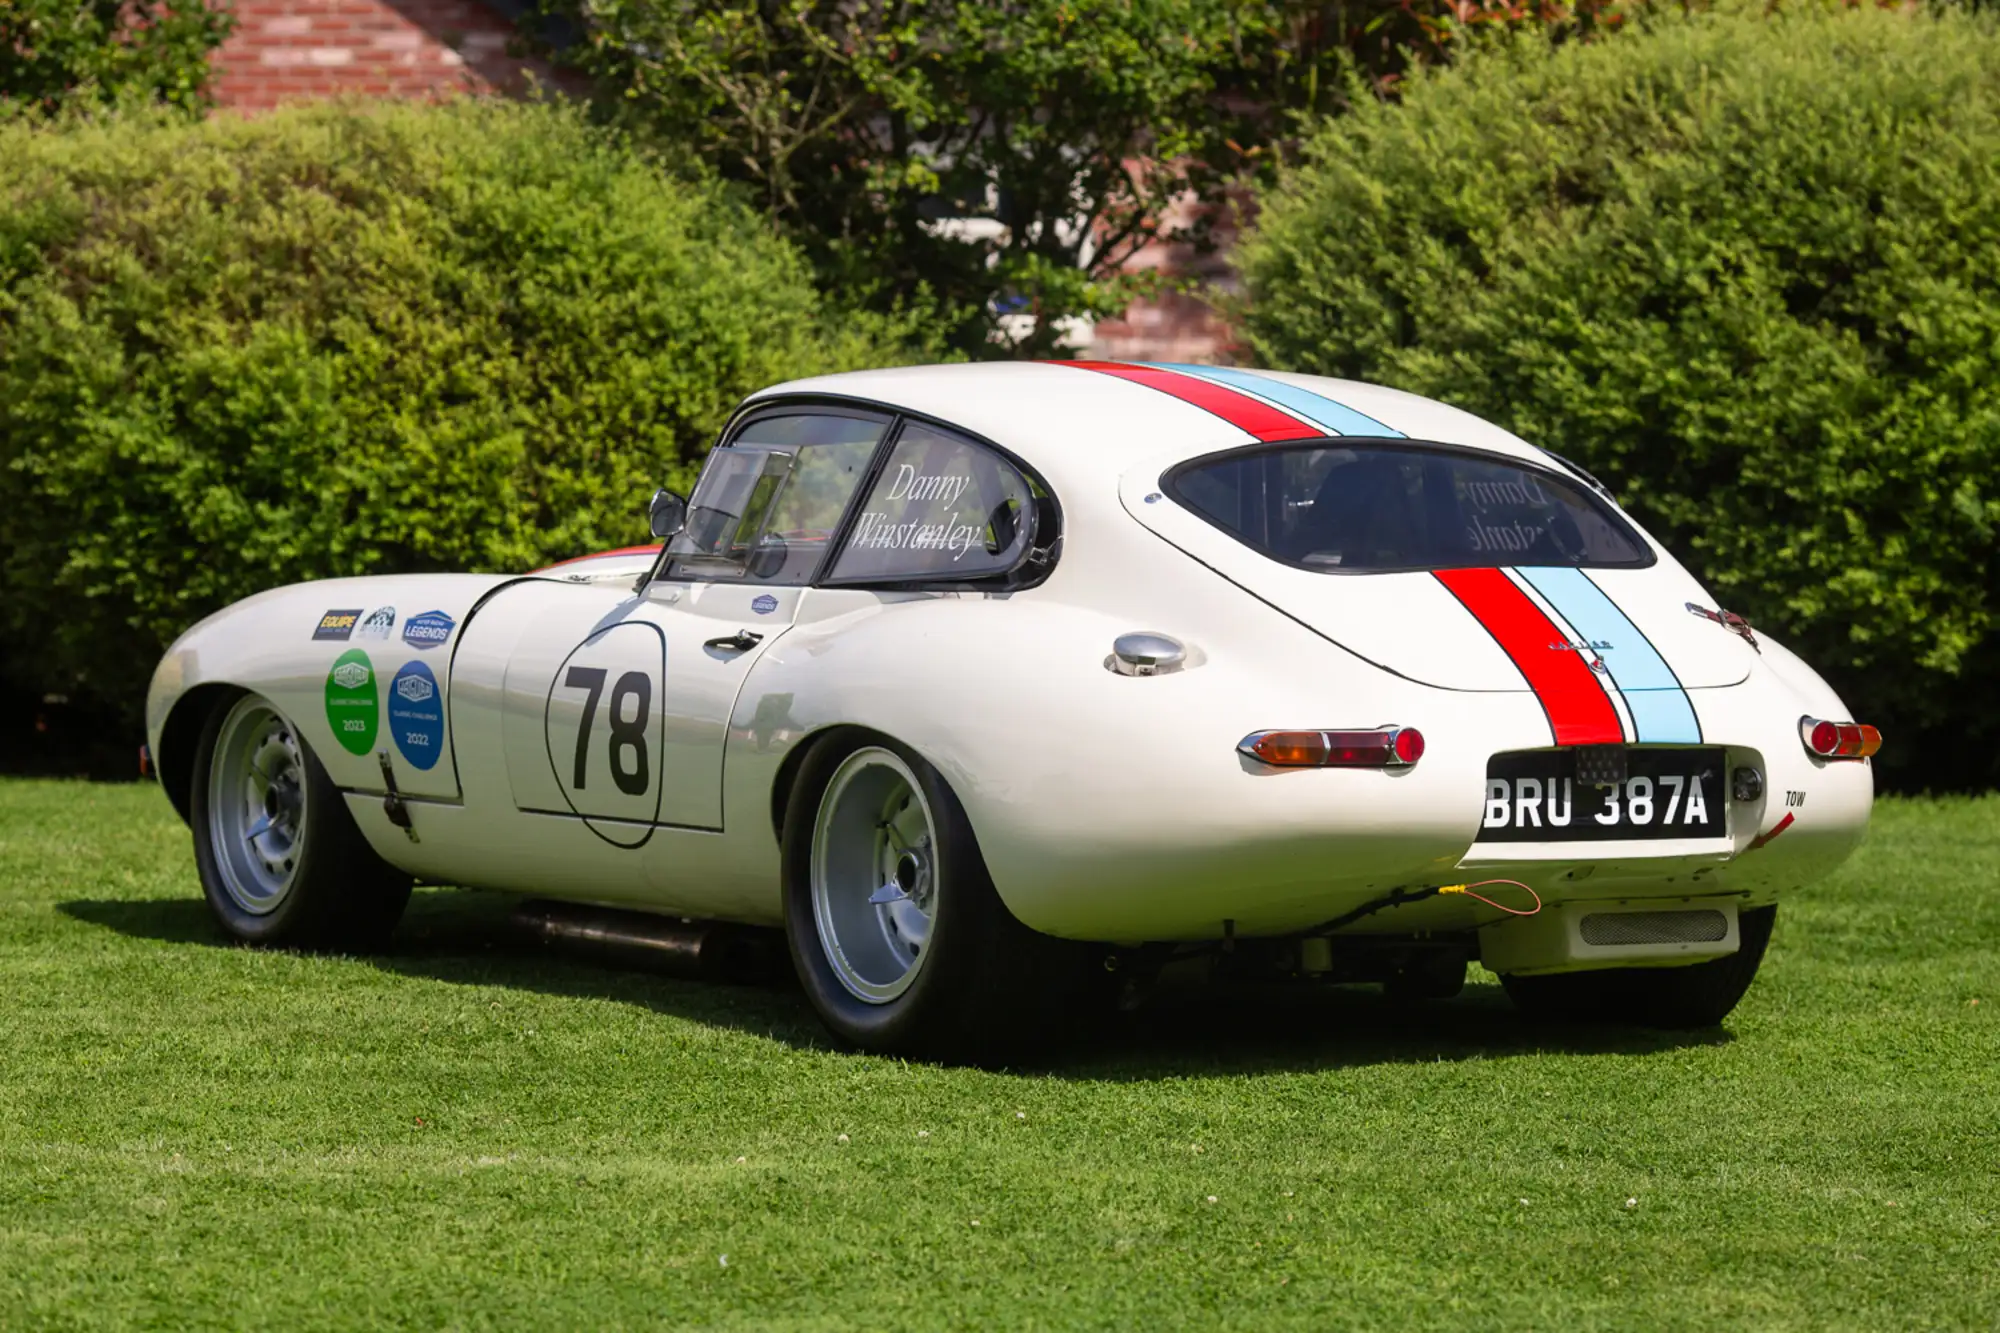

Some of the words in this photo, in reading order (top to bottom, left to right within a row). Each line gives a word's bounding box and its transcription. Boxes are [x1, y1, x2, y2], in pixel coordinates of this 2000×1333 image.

[886, 464, 970, 511] Danny
[851, 512, 980, 561] Winstanley
[320, 614, 357, 629] EQUIPE
[405, 626, 448, 640] LEGENDS
[342, 720, 366, 732] 2023
[565, 666, 652, 796] 78
[406, 732, 429, 746] 2022
[1484, 777, 1572, 829] BRU
[1595, 775, 1709, 826] 387A
[1786, 790, 1807, 808] TOW
